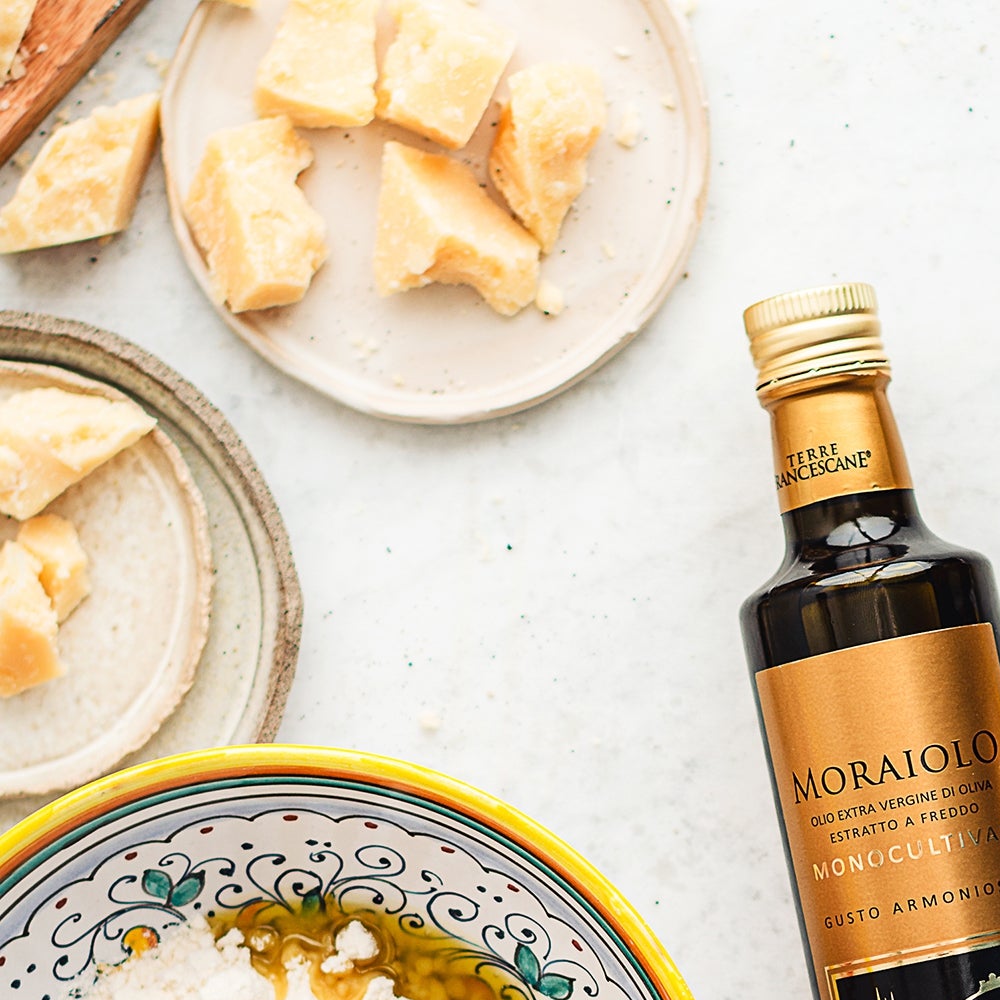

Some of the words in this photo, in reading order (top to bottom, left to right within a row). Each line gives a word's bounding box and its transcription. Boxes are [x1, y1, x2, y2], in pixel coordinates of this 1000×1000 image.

[786, 443, 838, 467] TERRE
[792, 730, 998, 804] MORAIOLO
[811, 812, 835, 827] OLIO
[838, 804, 876, 821] EXTRA
[879, 790, 938, 811] VERGINE
[942, 787, 955, 799] DI
[958, 780, 993, 796] OLIVA
[830, 819, 898, 844] ESTRATTO
[905, 816, 915, 827] A
[921, 803, 979, 824] FREDDO
[824, 906, 880, 929] GUSTO
